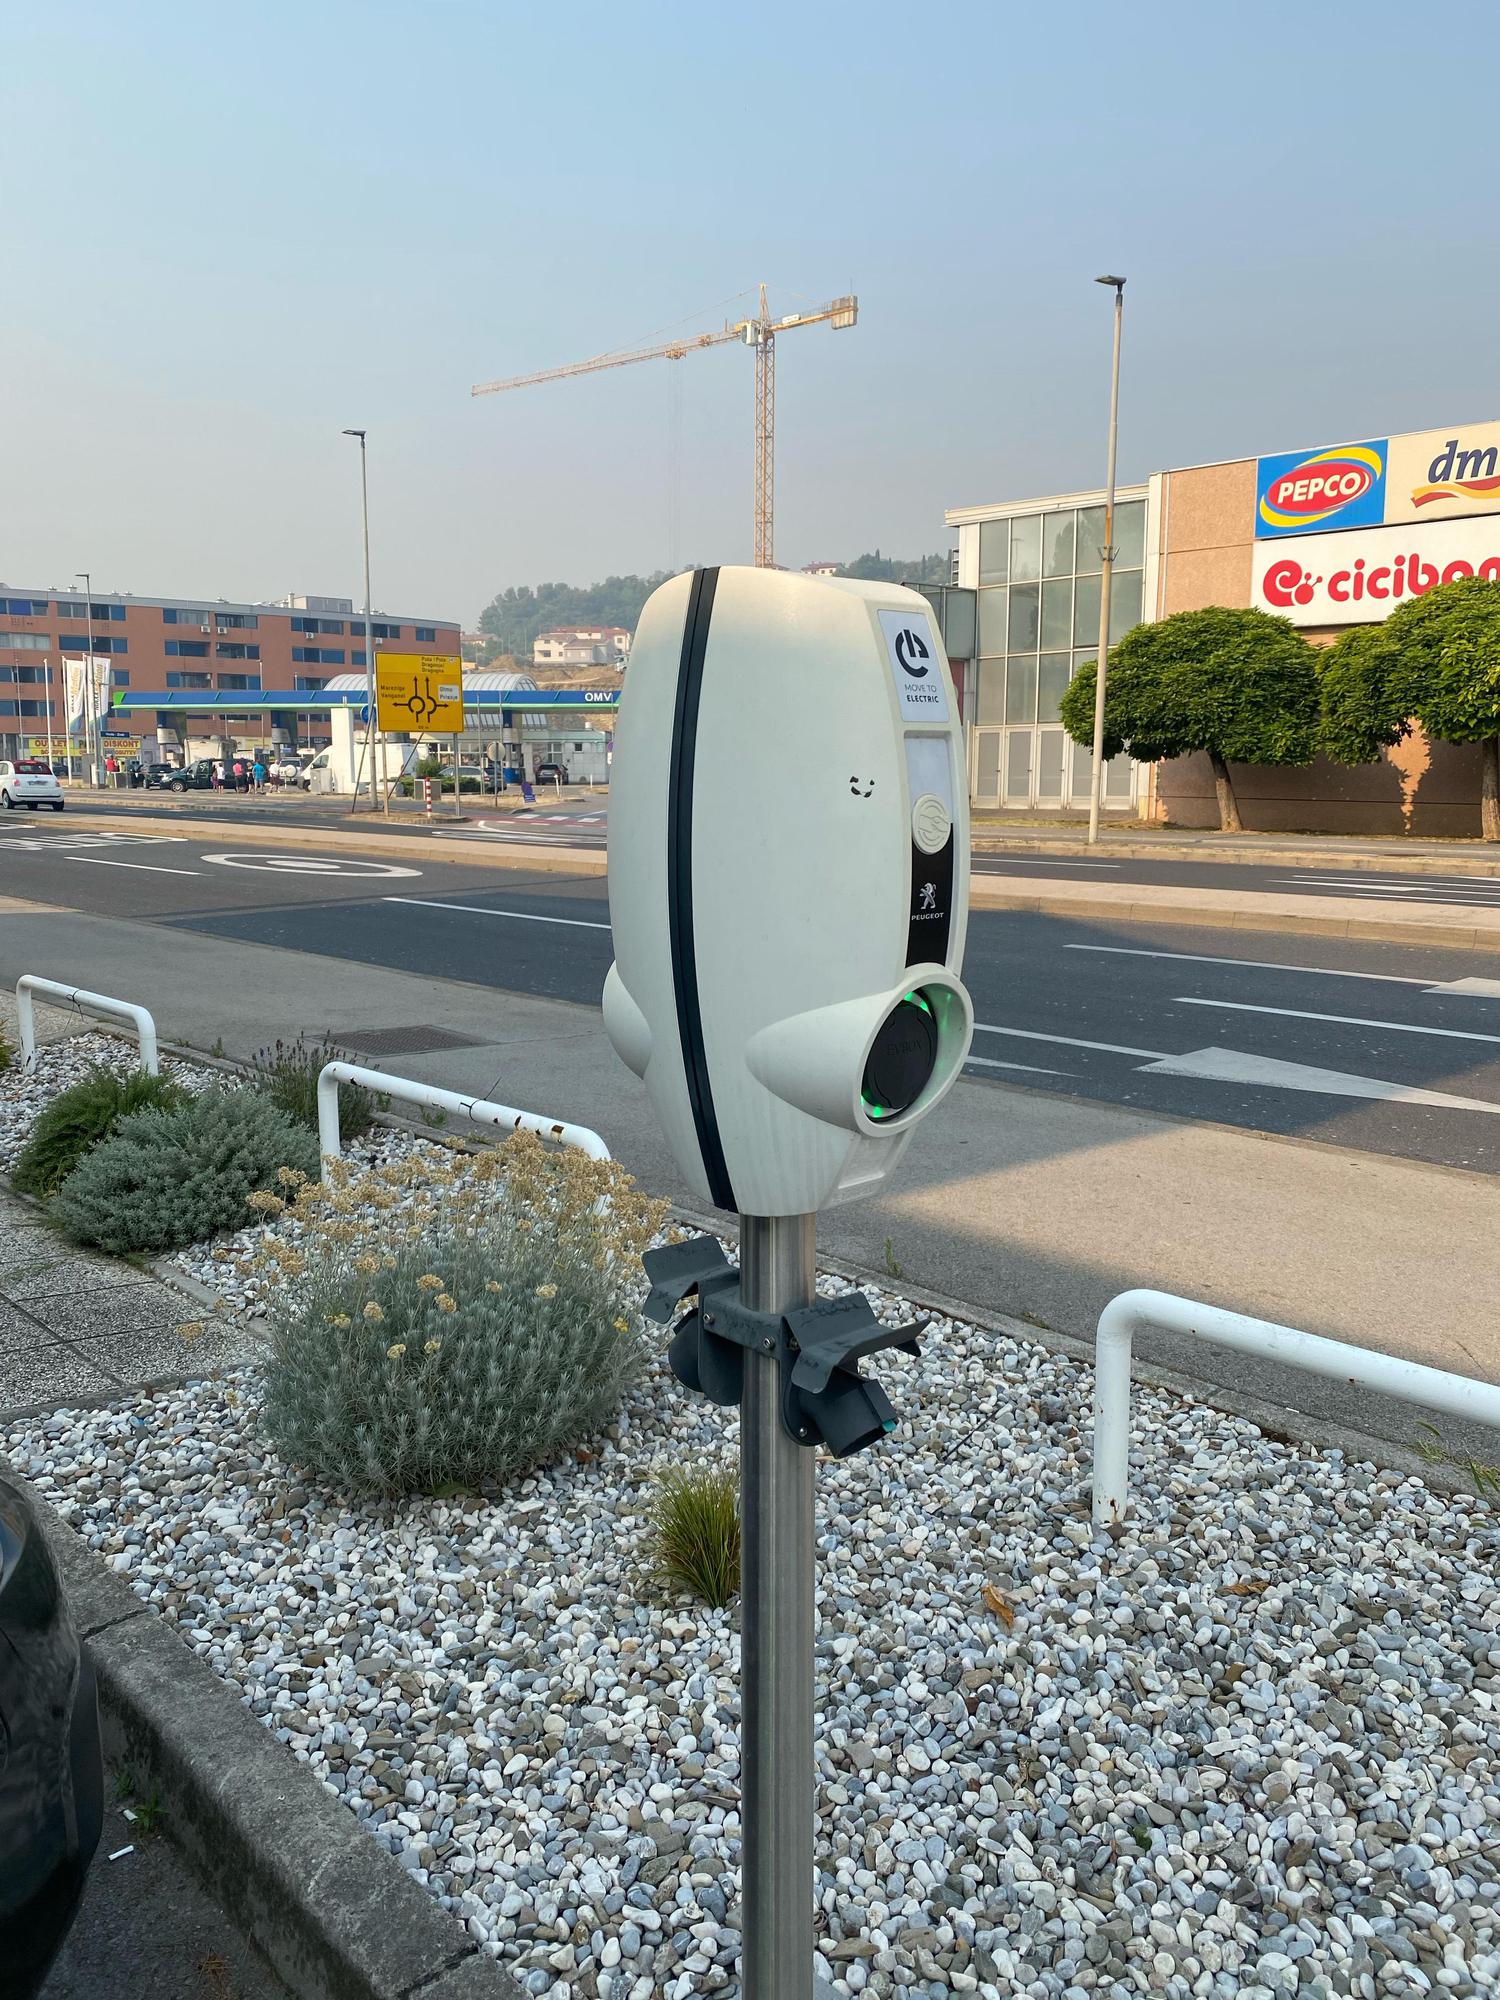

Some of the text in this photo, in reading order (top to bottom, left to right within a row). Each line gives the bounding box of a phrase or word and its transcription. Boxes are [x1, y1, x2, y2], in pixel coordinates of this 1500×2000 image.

[1428, 440, 1499, 483] dm
[1277, 472, 1362, 503] PEPCO
[904, 683, 937, 693] MOVE TO
[584, 692, 612, 702] OMV
[906, 694, 939, 703] ELECTRIC
[104, 740, 139, 748] DISKONT
[911, 912, 944, 921] PEUGEOT
